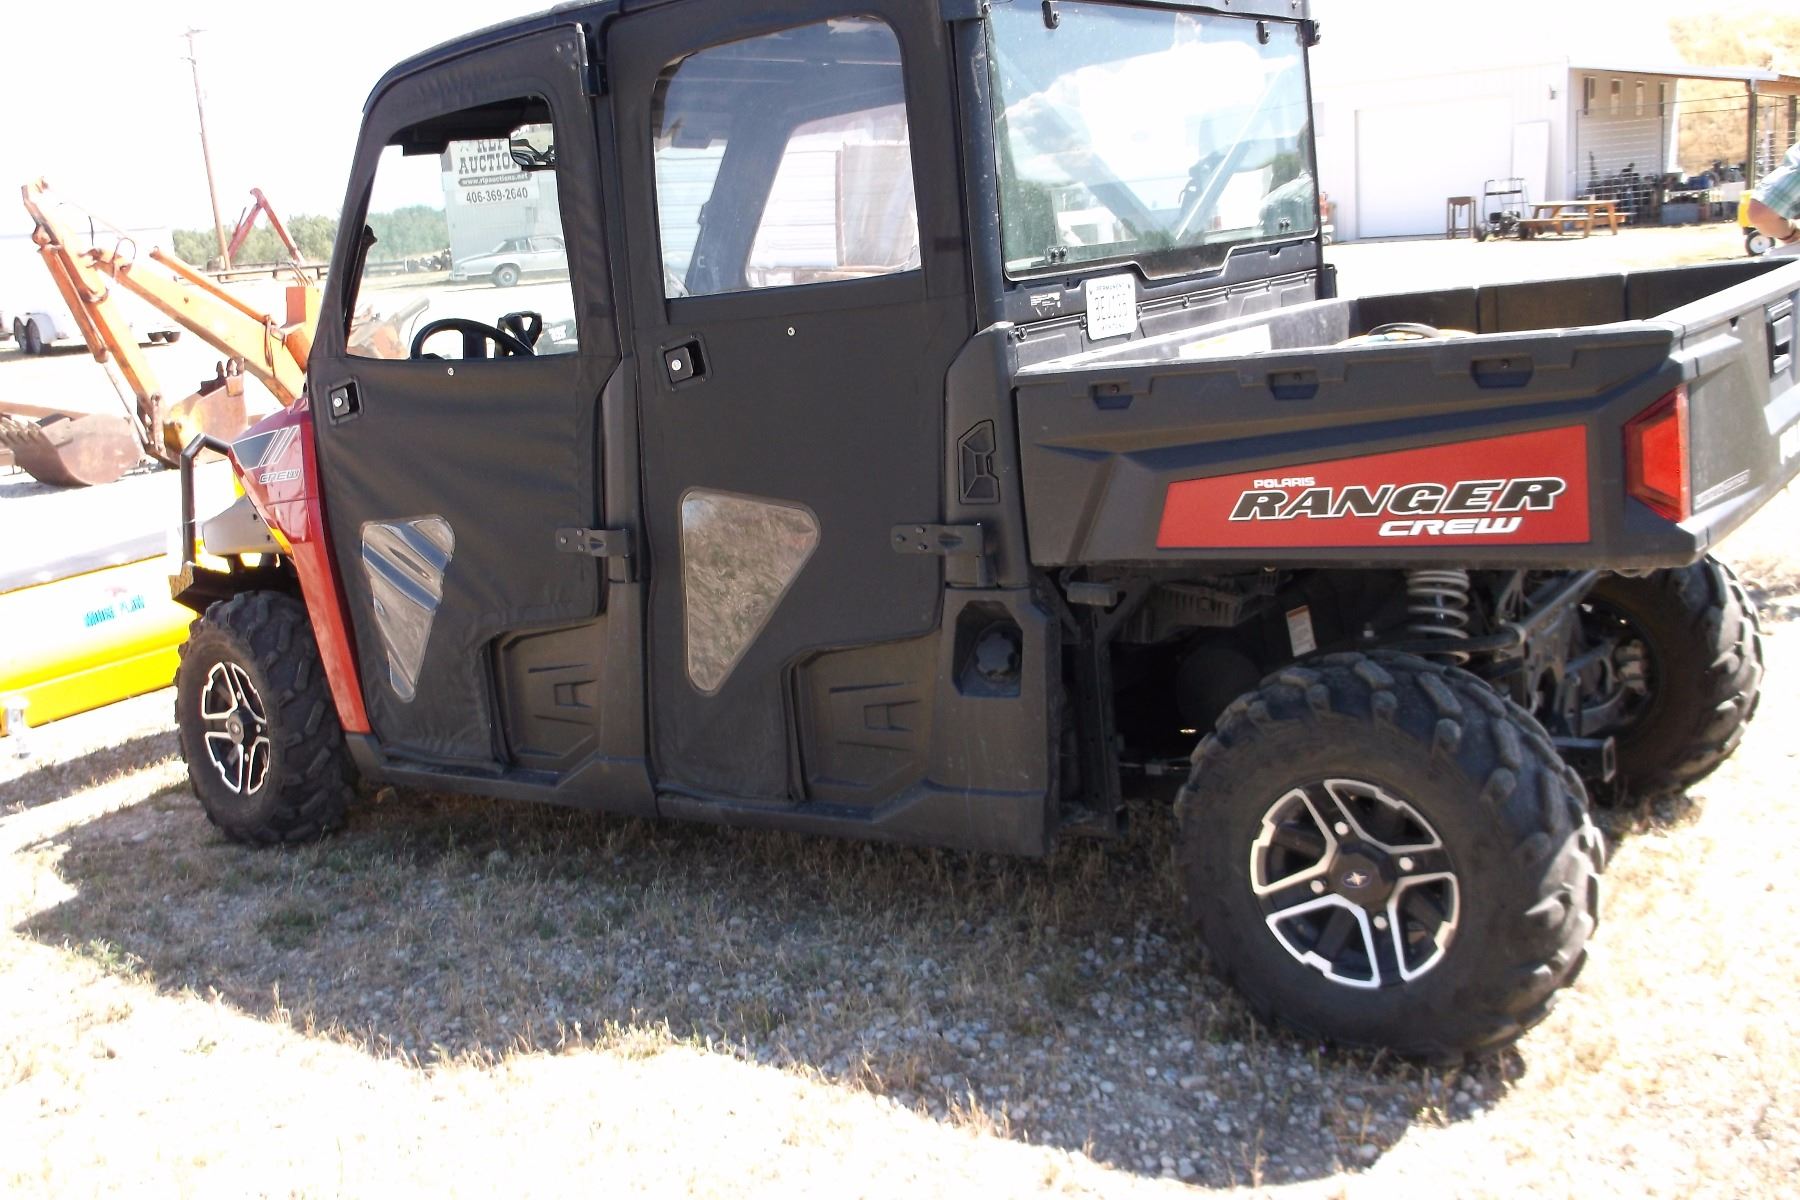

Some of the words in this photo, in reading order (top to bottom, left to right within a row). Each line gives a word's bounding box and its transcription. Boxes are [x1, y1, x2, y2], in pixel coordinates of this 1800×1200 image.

[466, 187, 528, 203] 406-369-2640
[260, 469, 301, 484] CREW
[1254, 477, 1316, 489] POLARIS
[1228, 476, 1567, 521] RANGER
[1378, 516, 1524, 538] CREW
